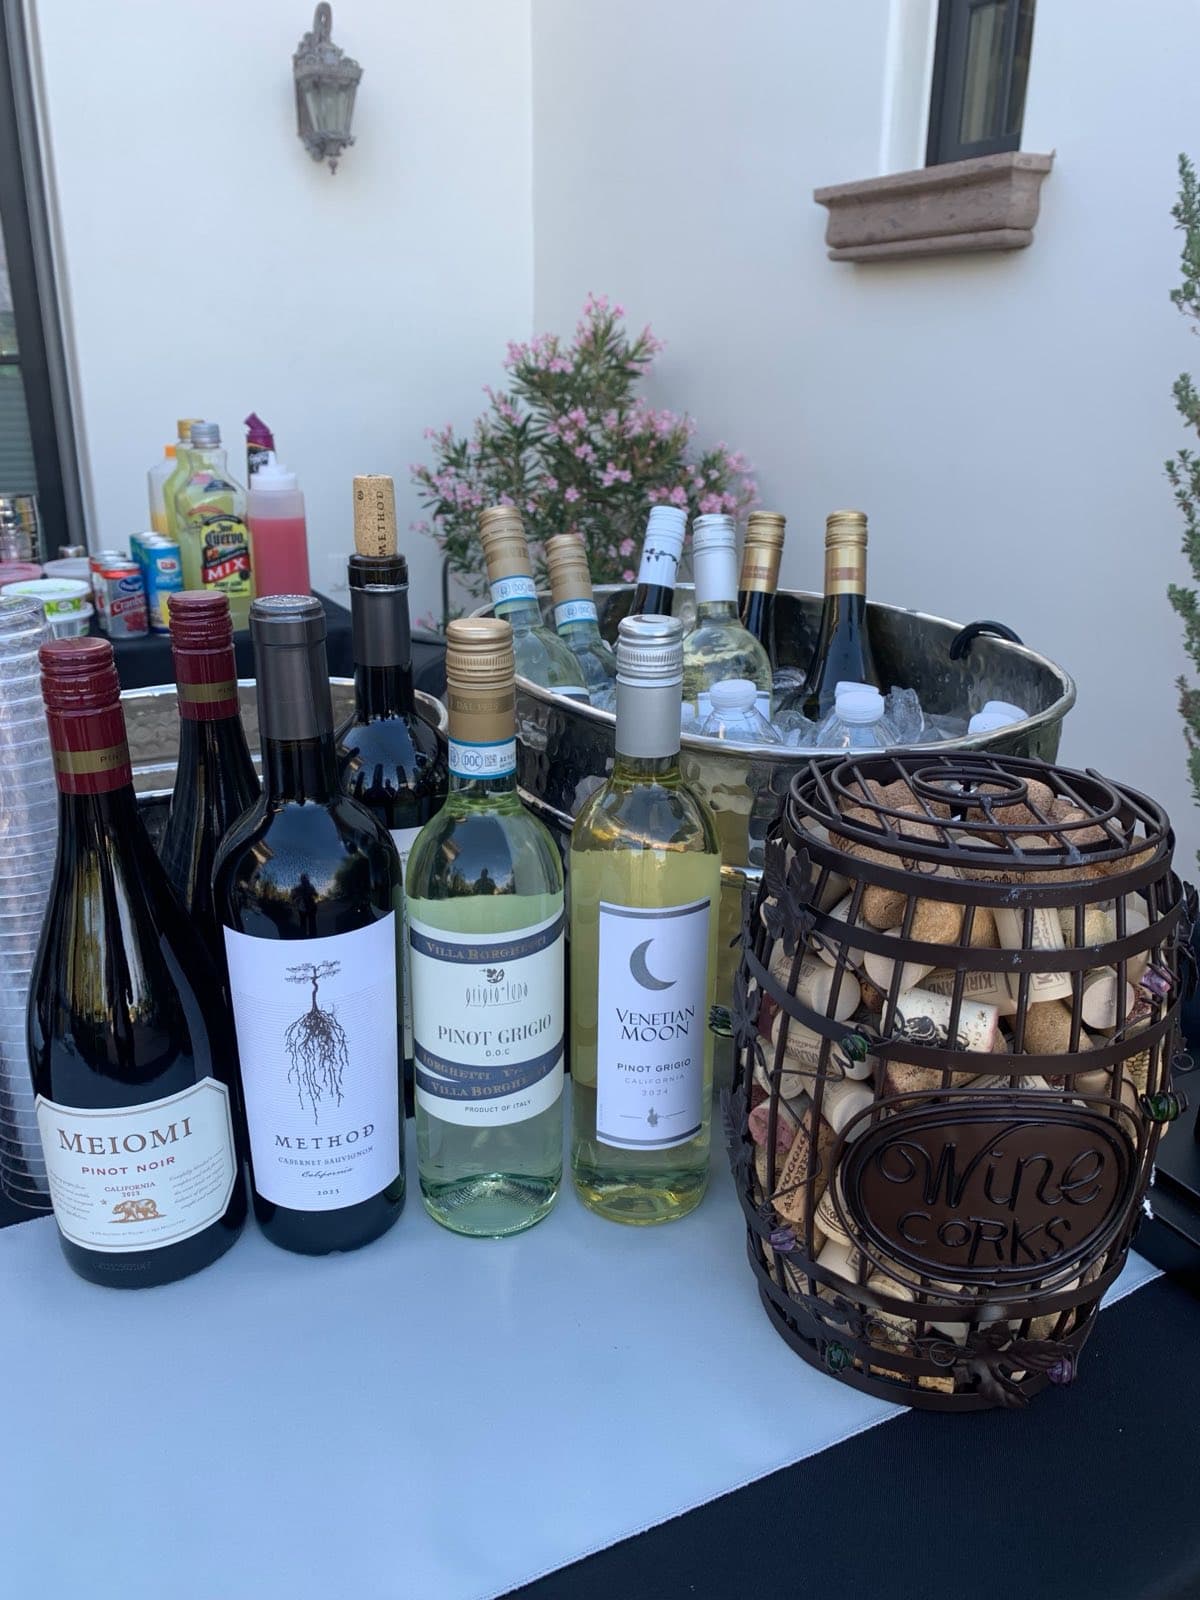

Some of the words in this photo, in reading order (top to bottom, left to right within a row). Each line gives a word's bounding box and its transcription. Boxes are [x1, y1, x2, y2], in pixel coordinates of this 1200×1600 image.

[375, 490, 387, 557] METHOD
[208, 557, 245, 580] MIX
[426, 941, 465, 959] VILLA
[616, 1004, 695, 1026] VENETIAN
[438, 1025, 492, 1046] PINOT
[498, 1014, 552, 1045] GRIGIO
[621, 1021, 689, 1042] MOON
[617, 1062, 651, 1073] PINOT
[655, 1058, 691, 1073] GRIGIO
[431, 1081, 469, 1097] VILLA
[625, 1073, 686, 1085] CALIFORNIA
[501, 1104, 510, 1112] OF
[513, 1100, 532, 1109] ITALY
[57, 1116, 194, 1156] MEIOMI
[81, 1166, 129, 1177] PINOT
[136, 1156, 176, 1173] NOIR
[278, 1156, 322, 1167] CABERNET
[324, 1145, 375, 1166] SAUVIGNON
[878, 1122, 1106, 1212] Wine
[104, 1181, 156, 1193] CALIFORNIA
